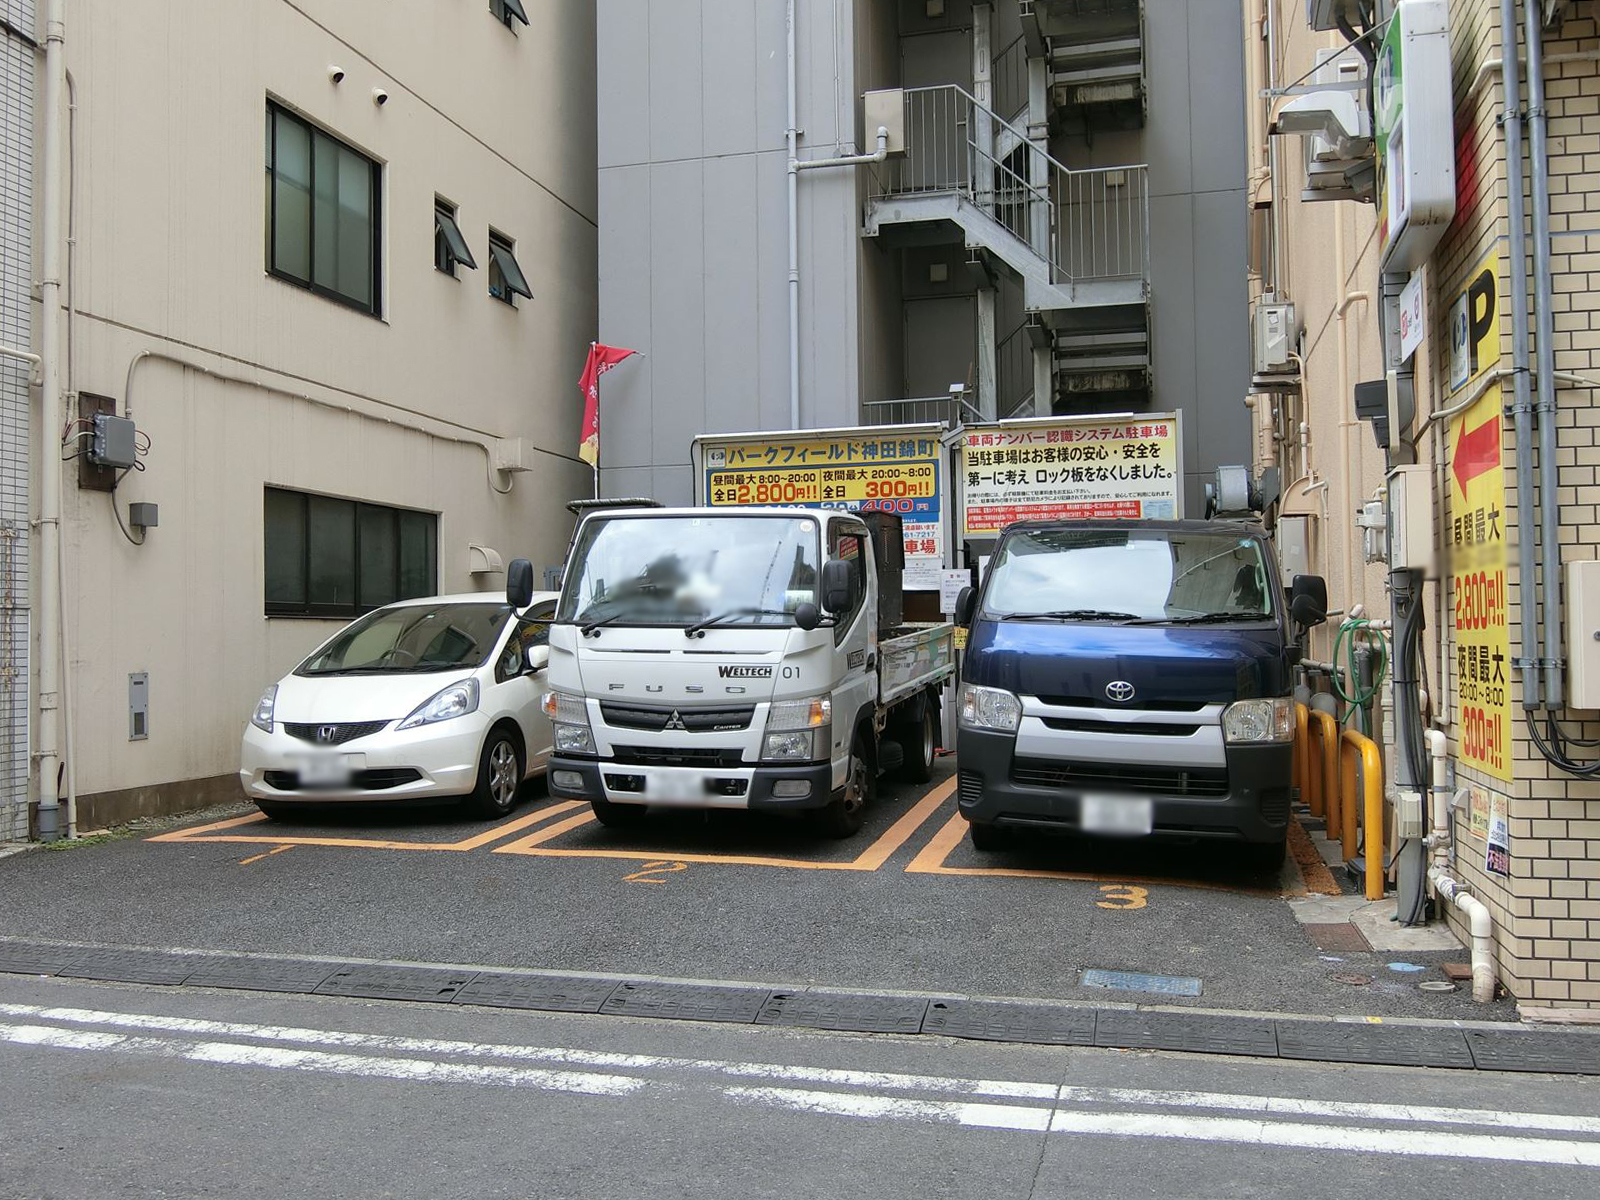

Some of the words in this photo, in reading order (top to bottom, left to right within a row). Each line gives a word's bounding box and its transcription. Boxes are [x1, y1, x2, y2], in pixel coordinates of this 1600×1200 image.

[1469, 269, 1496, 376] P
[968, 425, 1168, 447] 車両ナンバー認識システム駐車場
[728, 439, 935, 464] パークフィールド神田錦町
[968, 442, 1160, 467] 当駐車場はお客様の安心・安全を
[713, 474, 757, 486] 昼間最大
[823, 469, 868, 481] 夜間最大
[968, 470, 1030, 487] 第一に考え
[1036, 463, 1173, 484] ロック板をなくしました。
[714, 488, 737, 502] 全日
[823, 485, 846, 499] 全日
[718, 665, 772, 679] WELTECH
[782, 667, 800, 679] 01
[1457, 644, 1505, 685] 夜間最大
[609, 684, 746, 693] FUSO
[622, 861, 688, 884] 2
[1096, 885, 1149, 909] 3
